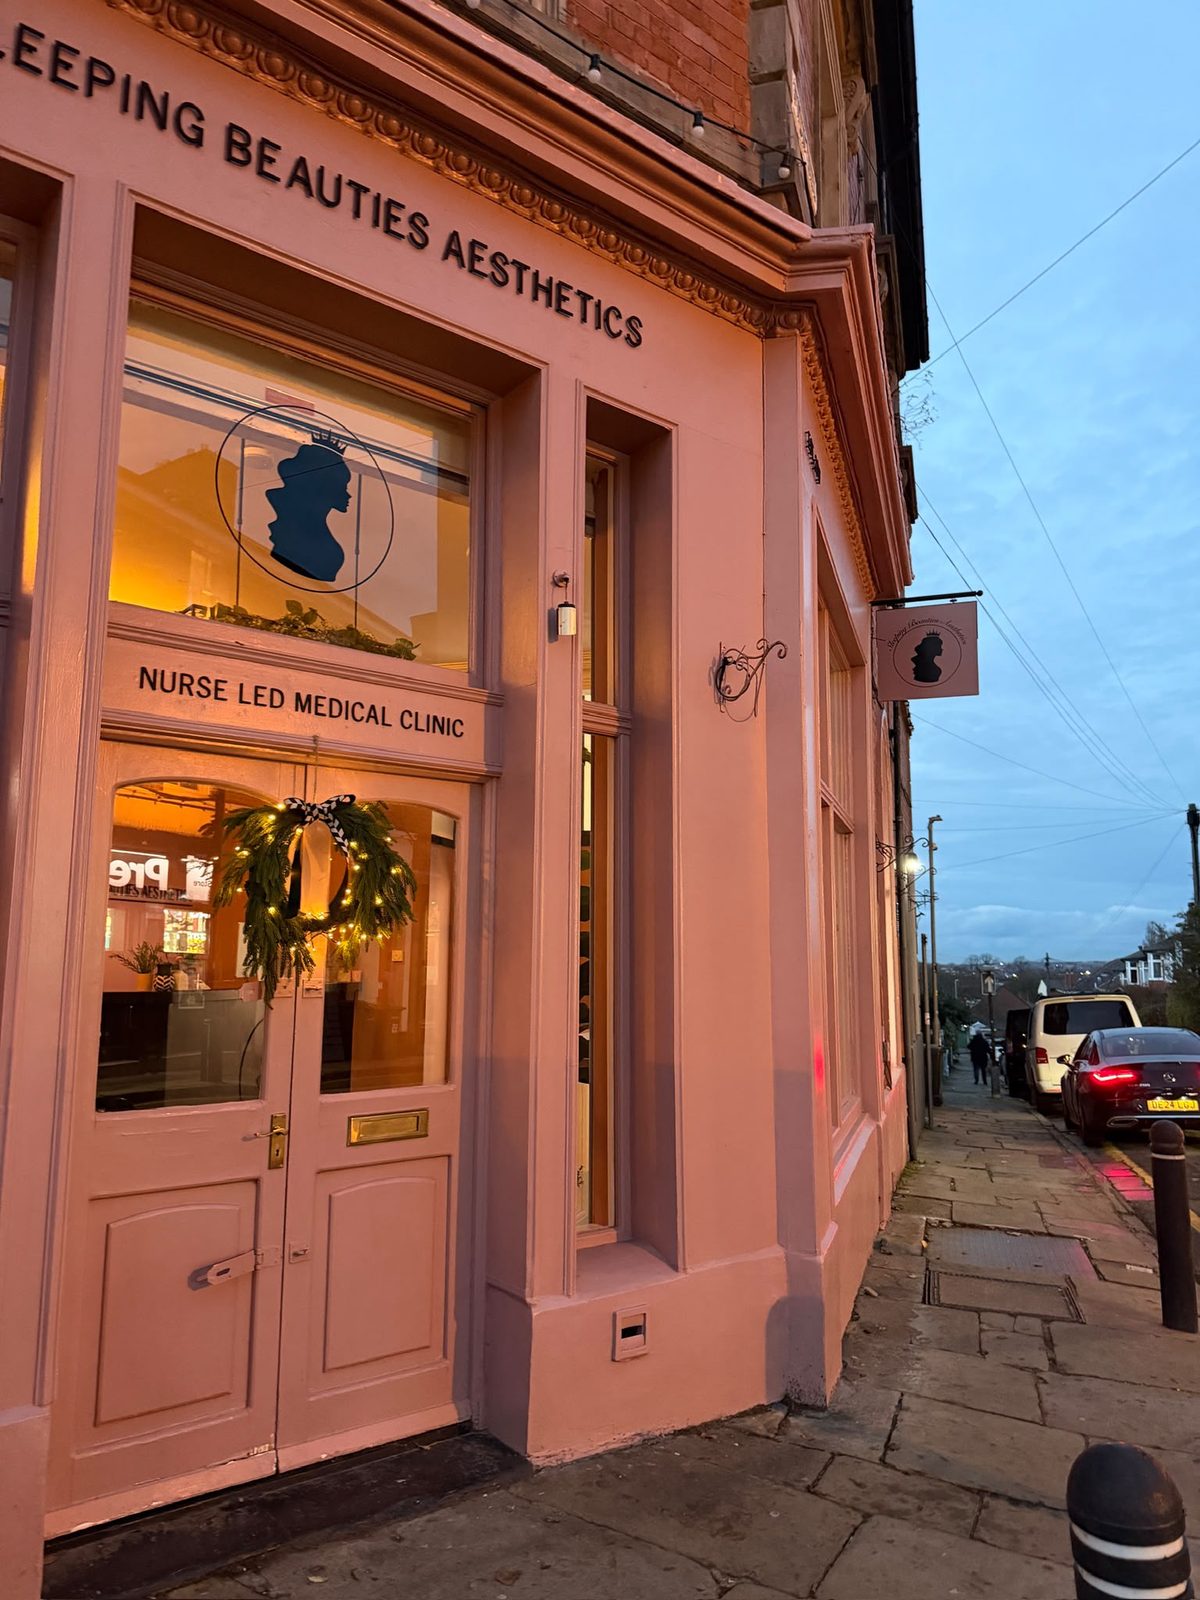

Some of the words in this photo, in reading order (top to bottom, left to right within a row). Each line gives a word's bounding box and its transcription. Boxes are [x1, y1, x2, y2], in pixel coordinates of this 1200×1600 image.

[0, 22, 204, 148] EEPING
[223, 122, 430, 250] BEAUTIES
[442, 229, 645, 349] AESTHETICS
[138, 666, 228, 701] NURSE
[238, 682, 285, 709] LED
[294, 692, 392, 727] MEDICAL
[399, 709, 465, 738] CLINIC
